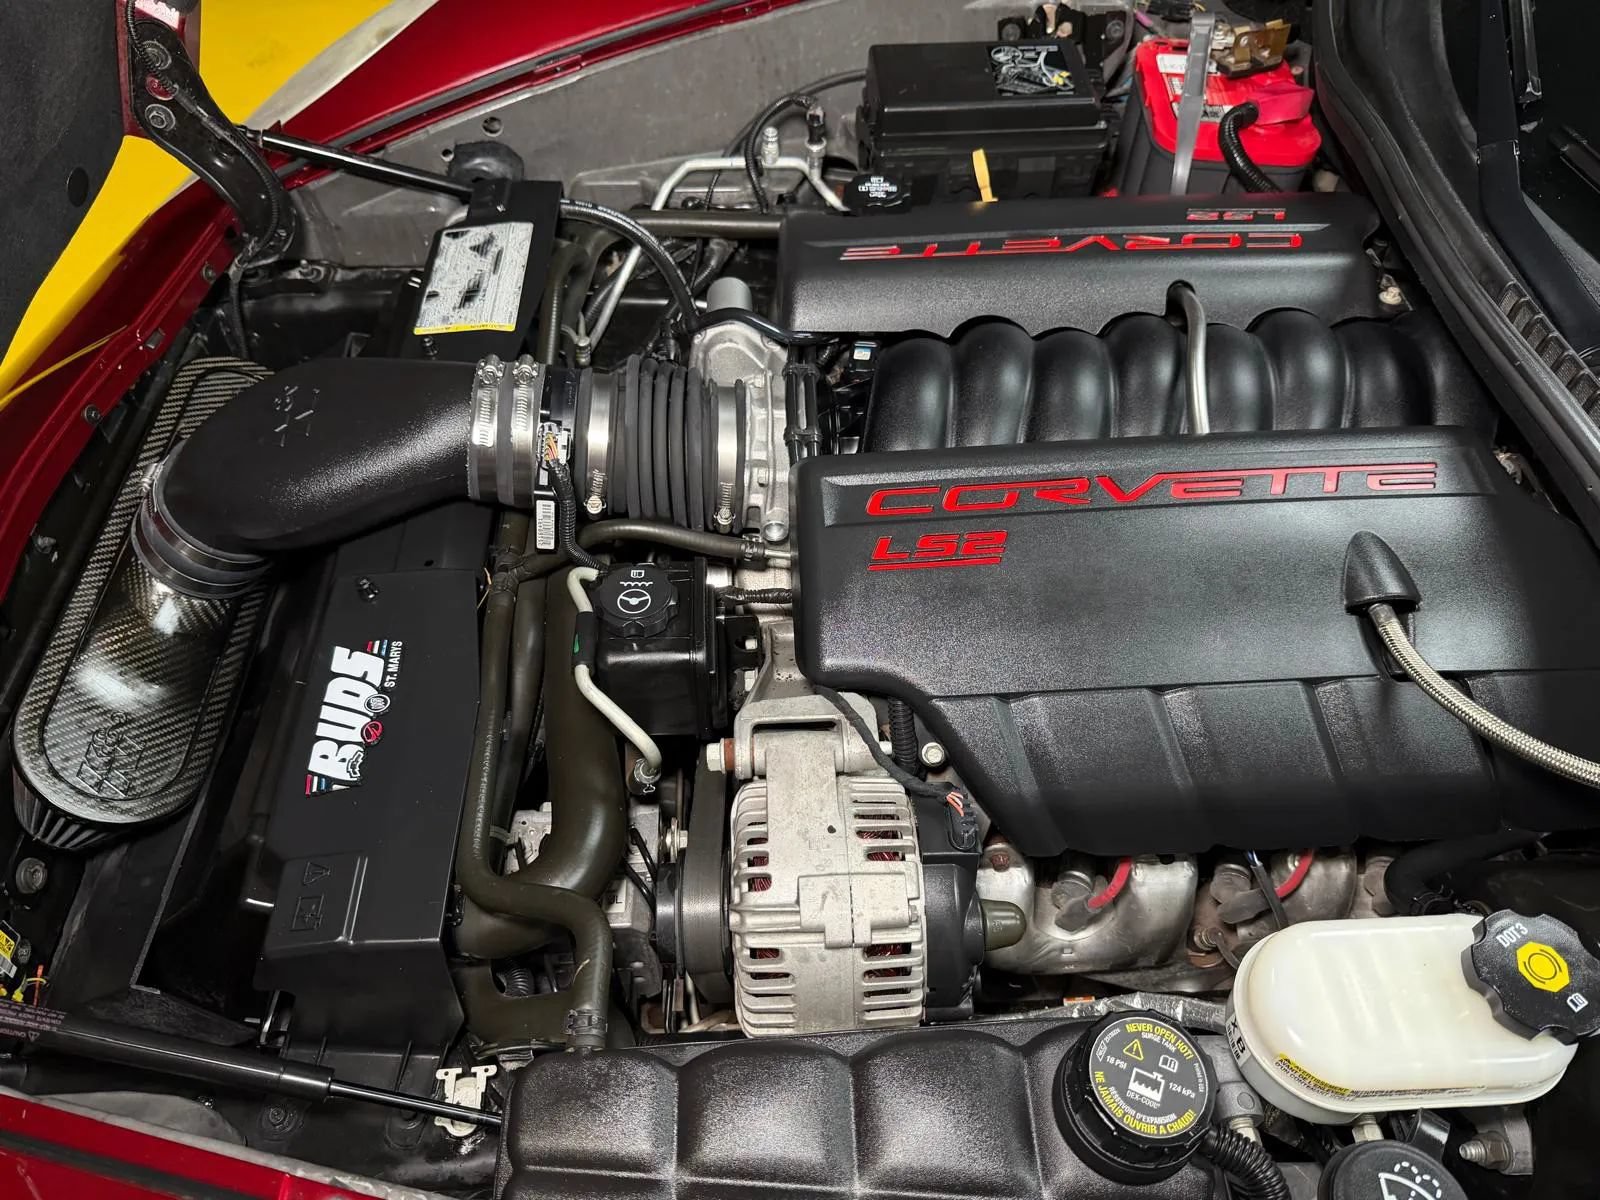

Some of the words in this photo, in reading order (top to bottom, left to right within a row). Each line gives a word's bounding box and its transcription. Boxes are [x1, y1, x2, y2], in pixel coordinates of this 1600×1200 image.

[839, 232, 1303, 261] CORVETTE
[866, 462, 1437, 516] CORVETTE
[872, 530, 1009, 561] LS2
[387, 641, 403, 673] MARYS
[307, 645, 385, 782] BUDS
[1125, 1023, 1153, 1033] NEVER
[1154, 1024, 1177, 1044] OPEN
[1175, 1039, 1194, 1060] HOT!
[1141, 1032, 1161, 1043] SURGE
[1161, 1038, 1177, 1053] TANK
[1094, 1070, 1105, 1084] NE
[1106, 1055, 1114, 1065] 18
[1115, 1058, 1127, 1070] PSI
[1098, 1085, 1124, 1118] JAMAIS
[1168, 1082, 1181, 1093] 124
[1181, 1086, 1196, 1099] kPa
[1123, 1114, 1157, 1134] OUVRIR
[1166, 1109, 1197, 1133] CHAUD!
